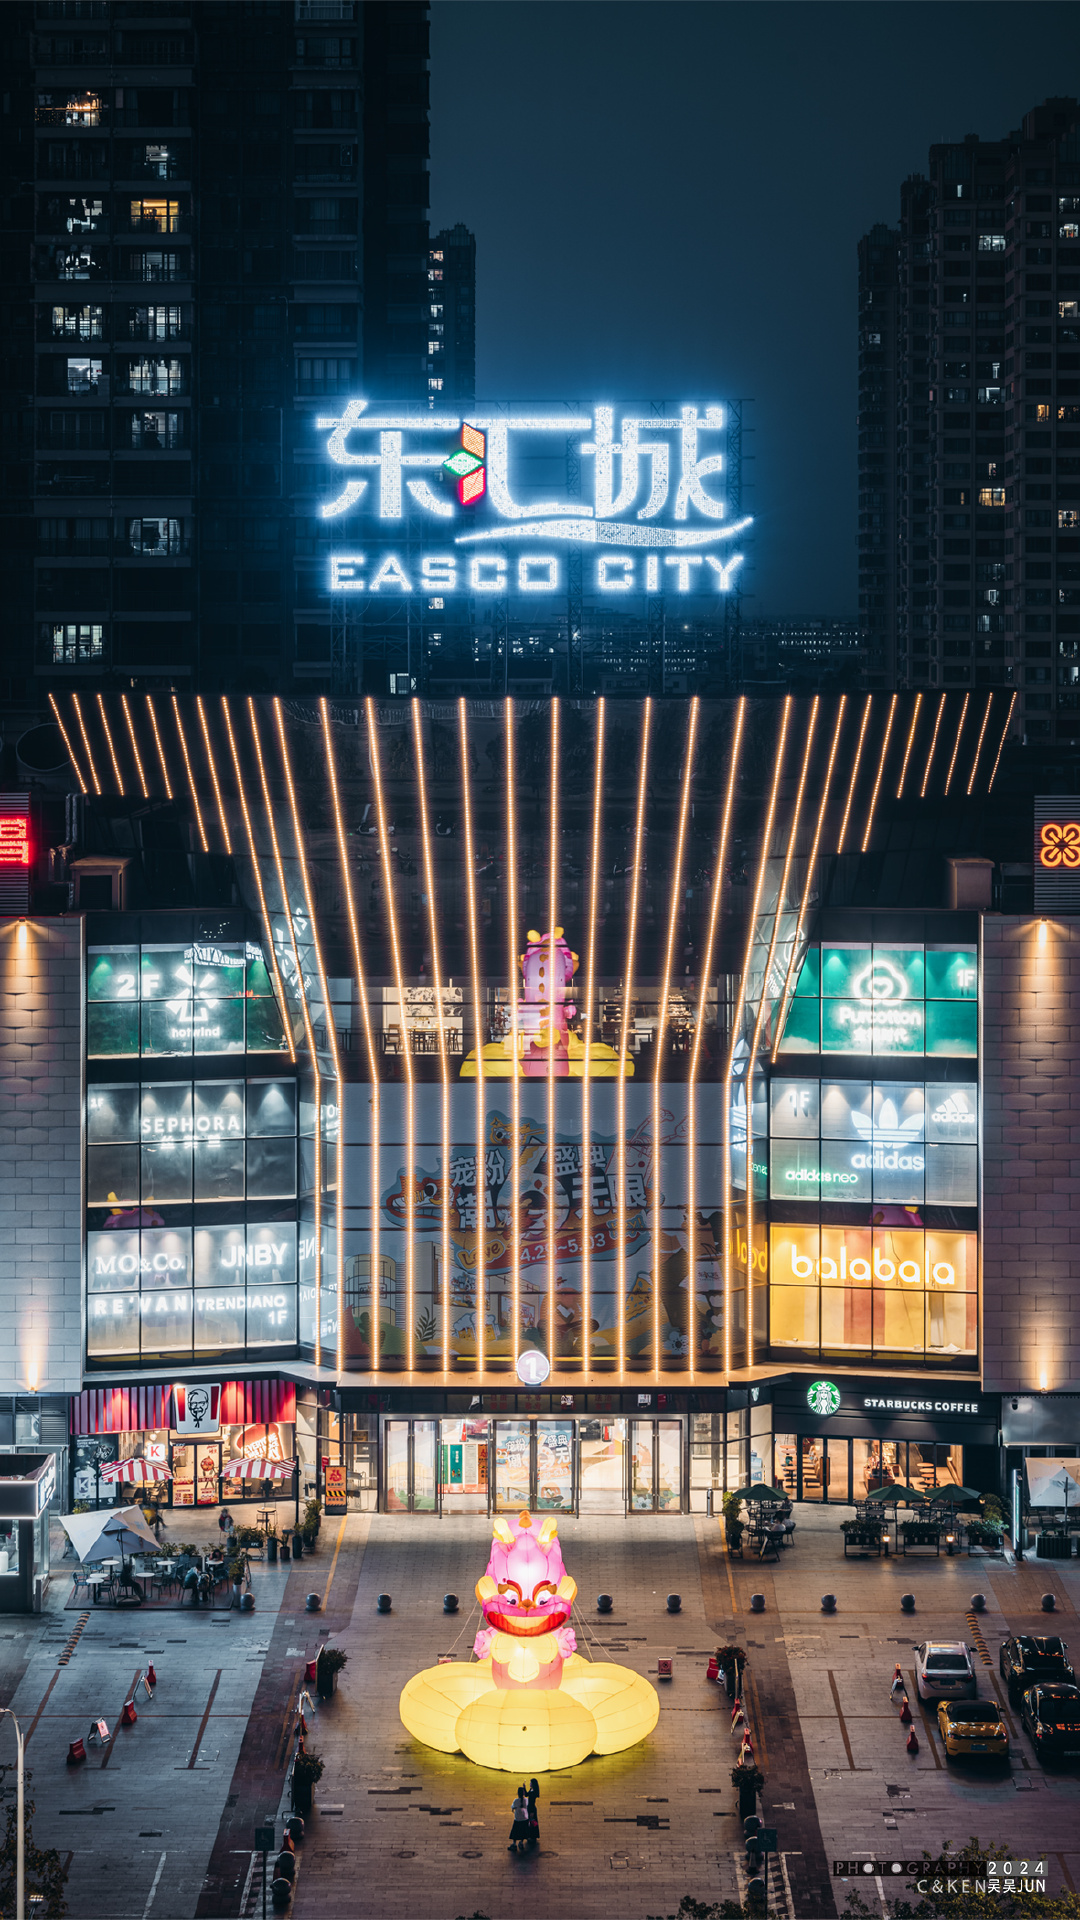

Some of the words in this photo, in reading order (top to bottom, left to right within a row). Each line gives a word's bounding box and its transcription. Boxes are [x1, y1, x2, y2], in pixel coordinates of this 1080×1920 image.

[317, 400, 724, 519] 东汇城
[330, 557, 558, 590] EASCO
[598, 557, 744, 590] CITY
[117, 974, 160, 997] 2F
[957, 969, 975, 987] 1F
[171, 1026, 220, 1038] hotwind
[789, 1091, 809, 1107] 1F
[142, 1116, 240, 1133] SEPHORA
[932, 1111, 975, 1123] adidas
[851, 1152, 924, 1170] adidas
[785, 1169, 831, 1182] adidas
[833, 1173, 858, 1183] neo
[95, 1253, 185, 1274] MO&Co.
[221, 1243, 287, 1268] JNBY
[791, 1244, 955, 1285] balabala
[197, 1295, 286, 1311] TRENDIANO
[268, 1311, 287, 1325] 1F
[526, 1357, 537, 1379] 1
[864, 1398, 933, 1411] STARBUCKS
[935, 1402, 978, 1413] COFFEE
[151, 1446, 160, 1457] K
